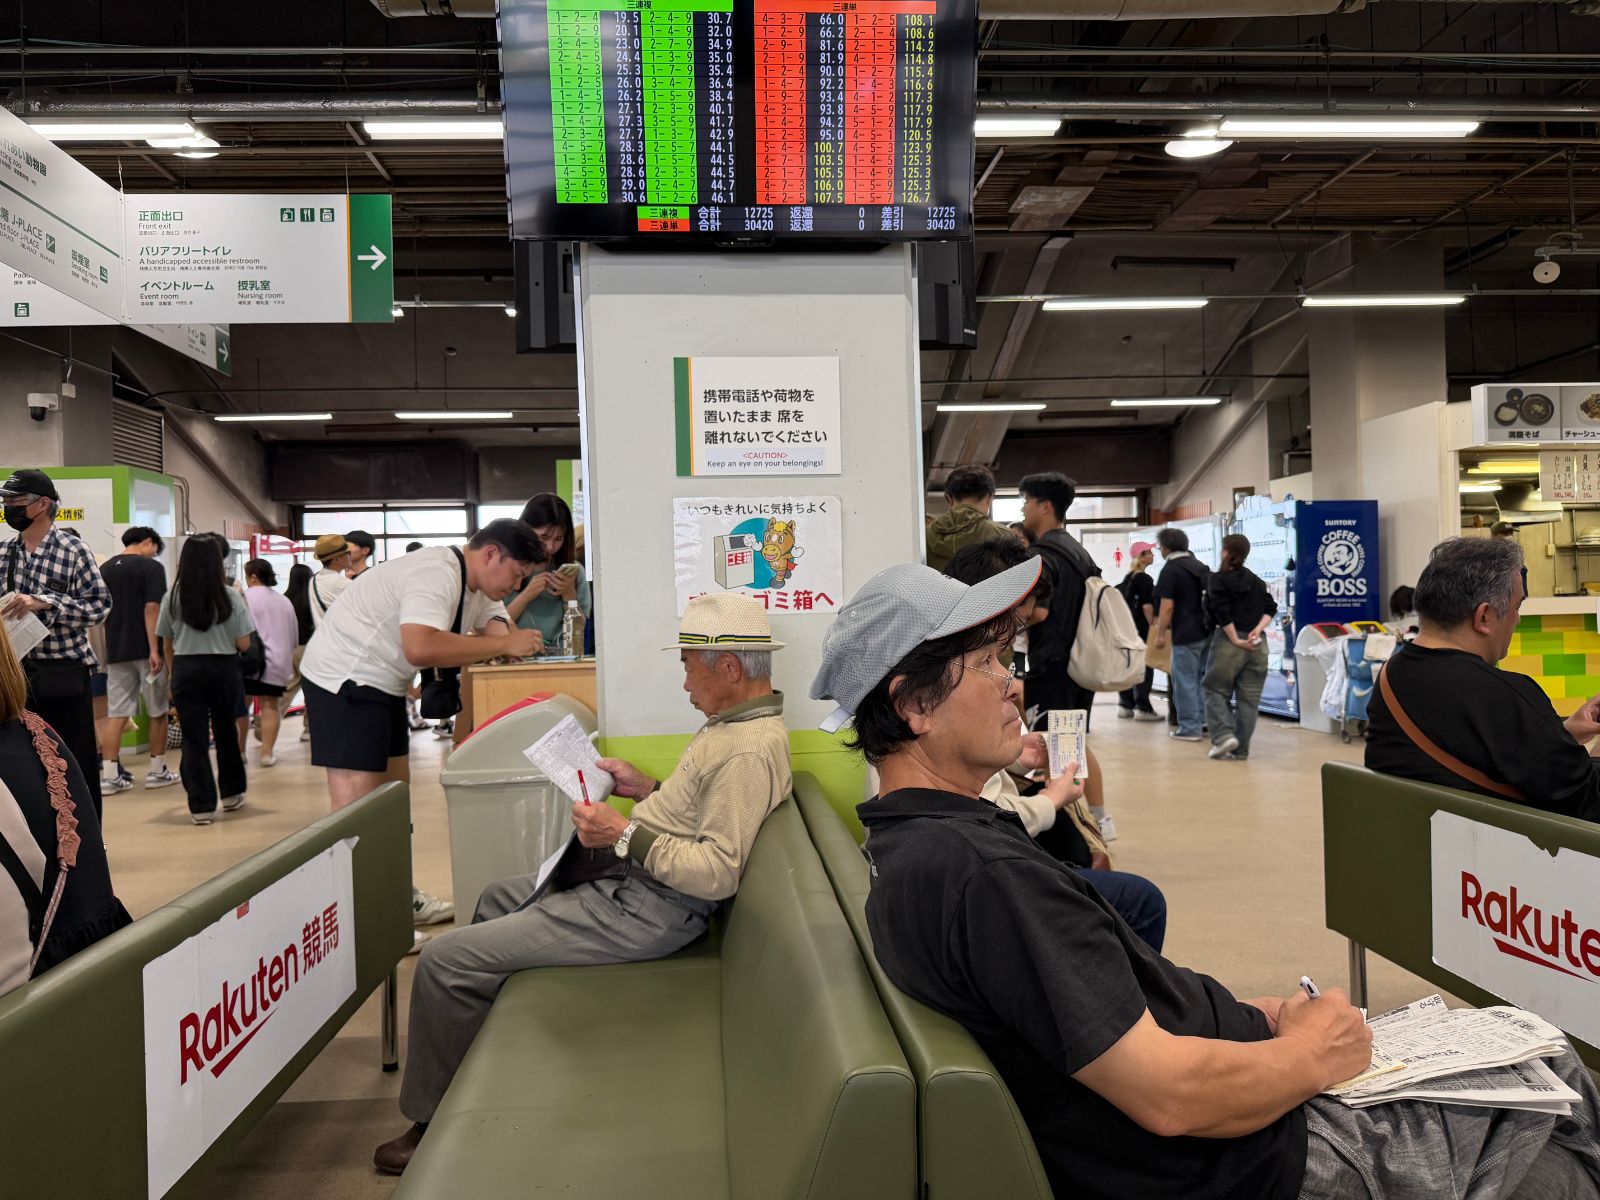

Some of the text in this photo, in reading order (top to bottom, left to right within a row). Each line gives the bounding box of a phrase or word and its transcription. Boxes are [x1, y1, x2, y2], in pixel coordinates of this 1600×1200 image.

[833, 3, 857, 11] 三連単
[615, 11, 638, 23] 19.5
[708, 12, 732, 24] 30.7
[820, 14, 844, 25] 66.0
[904, 15, 934, 26] 108.1
[616, 24, 732, 37] 20.1 32.0
[820, 26, 933, 39] 66.2 108.6
[616, 37, 732, 49] 23.0 34.9
[820, 39, 933, 52] 81.6 114.2
[616, 50, 732, 62] 24.4 35.0
[820, 52, 933, 64] 81.9 114.8
[617, 63, 640, 74] 25.3
[709, 63, 732, 75] 35.4
[820, 65, 843, 76] 90.0
[904, 65, 933, 77] 115.4
[618, 75, 732, 88] 26.0 36.4
[820, 77, 932, 90] 92.2 116.6
[618, 88, 733, 101] 26.2 38.4
[820, 90, 932, 102] 93.4 117.3
[618, 101, 733, 113] 27.1 40.1
[820, 103, 932, 115] 93.8 117.9
[619, 114, 733, 126] 27.3 41.7
[820, 116, 932, 128] 94.2 117.9
[620, 127, 643, 139] 27.7
[710, 128, 733, 139] 42.9
[820, 128, 843, 140] 95.0
[903, 129, 932, 141] 120.5
[620, 140, 733, 152] 28.3 44.1
[814, 141, 931, 153] 100.7 123.9
[0, 138, 47, 177] れあい動物園
[620, 153, 733, 165] 28.6 44.5
[814, 154, 931, 166] 103.5 125.3
[621, 166, 734, 177] 28.6 44.5
[814, 167, 931, 179] 105.5 125.3
[622, 179, 734, 190] 29.0 44.7
[814, 179, 931, 191] 106.0 125.3
[622, 192, 646, 203] 30.6
[712, 192, 734, 203] 46.1
[814, 192, 843, 203] 107.5
[902, 192, 930, 204] 126.7
[139, 210, 184, 222] 正面出口
[649, 207, 956, 219] 三連複 合計 12725 返還 0 差引 12725
[649, 219, 955, 231] 三連単 合計 30420 返還 0 差引 30420
[140, 246, 232, 256] バリアフリートイレ
[146, 258, 191, 266] handicapped
[140, 280, 272, 291] イベントルーム 授乳室
[237, 292, 264, 300] Nursing
[703, 388, 815, 404] 携帯電話や荷物を
[704, 409, 804, 424] 置いたまま 席を
[704, 430, 828, 445] 離れないでください
[742, 452, 789, 460] <CAUTION>
[707, 460, 726, 468] Keep
[782, 459, 824, 468] belongings!
[688, 501, 828, 516] いつもきれいに気持ちよく
[1321, 529, 1361, 545] COFFEE
[1316, 578, 1368, 596] BOSS
[180, 901, 339, 1086] Rakuten 競馬
